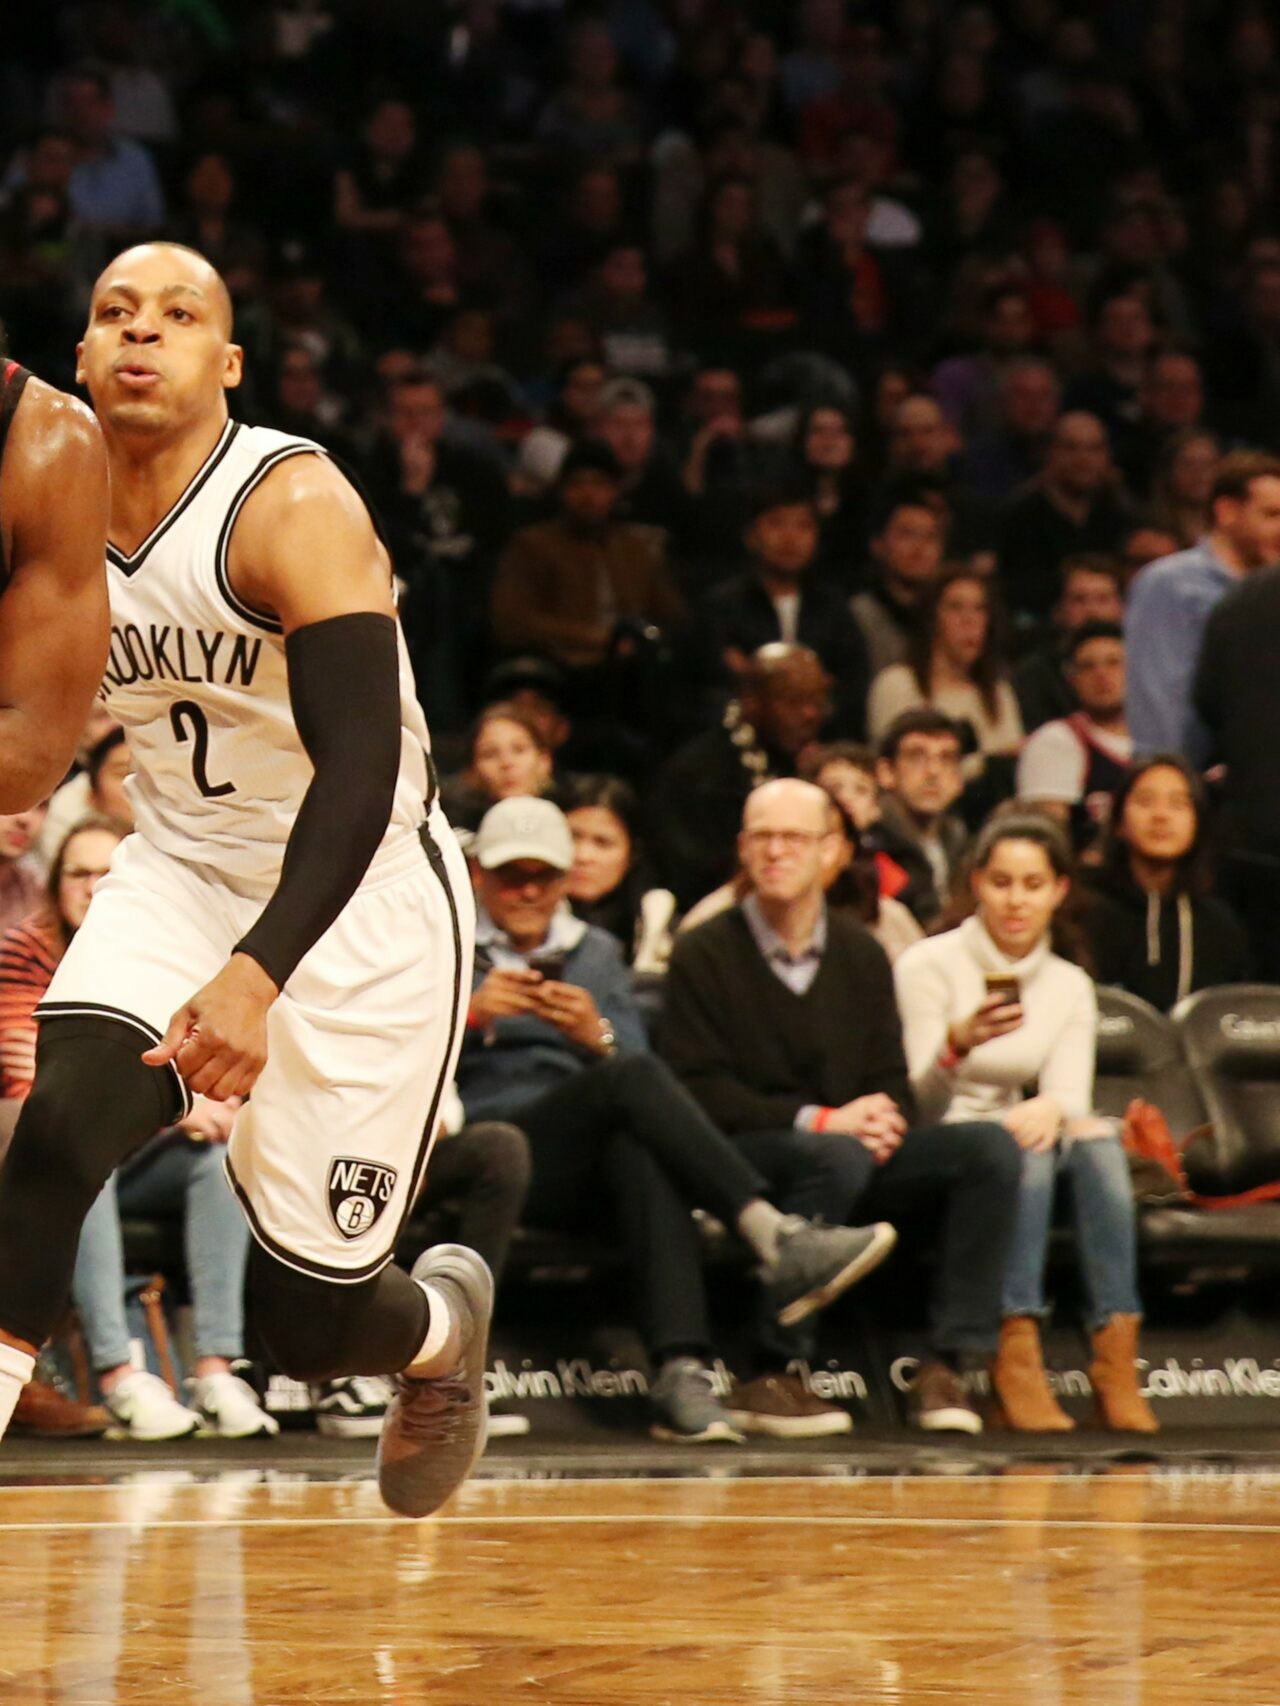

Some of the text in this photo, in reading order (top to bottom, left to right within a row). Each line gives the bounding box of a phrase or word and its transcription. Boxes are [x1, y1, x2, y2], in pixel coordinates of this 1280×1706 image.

[97, 623, 262, 702] OOKLYN
[169, 699, 237, 798] 2
[330, 1161, 396, 1202] NETS
[347, 1200, 365, 1229] B
[482, 1359, 562, 1400] alvin
[556, 1358, 650, 1398] Klein
[786, 1358, 868, 1399] lein
[1223, 1358, 1280, 1398] Kle
